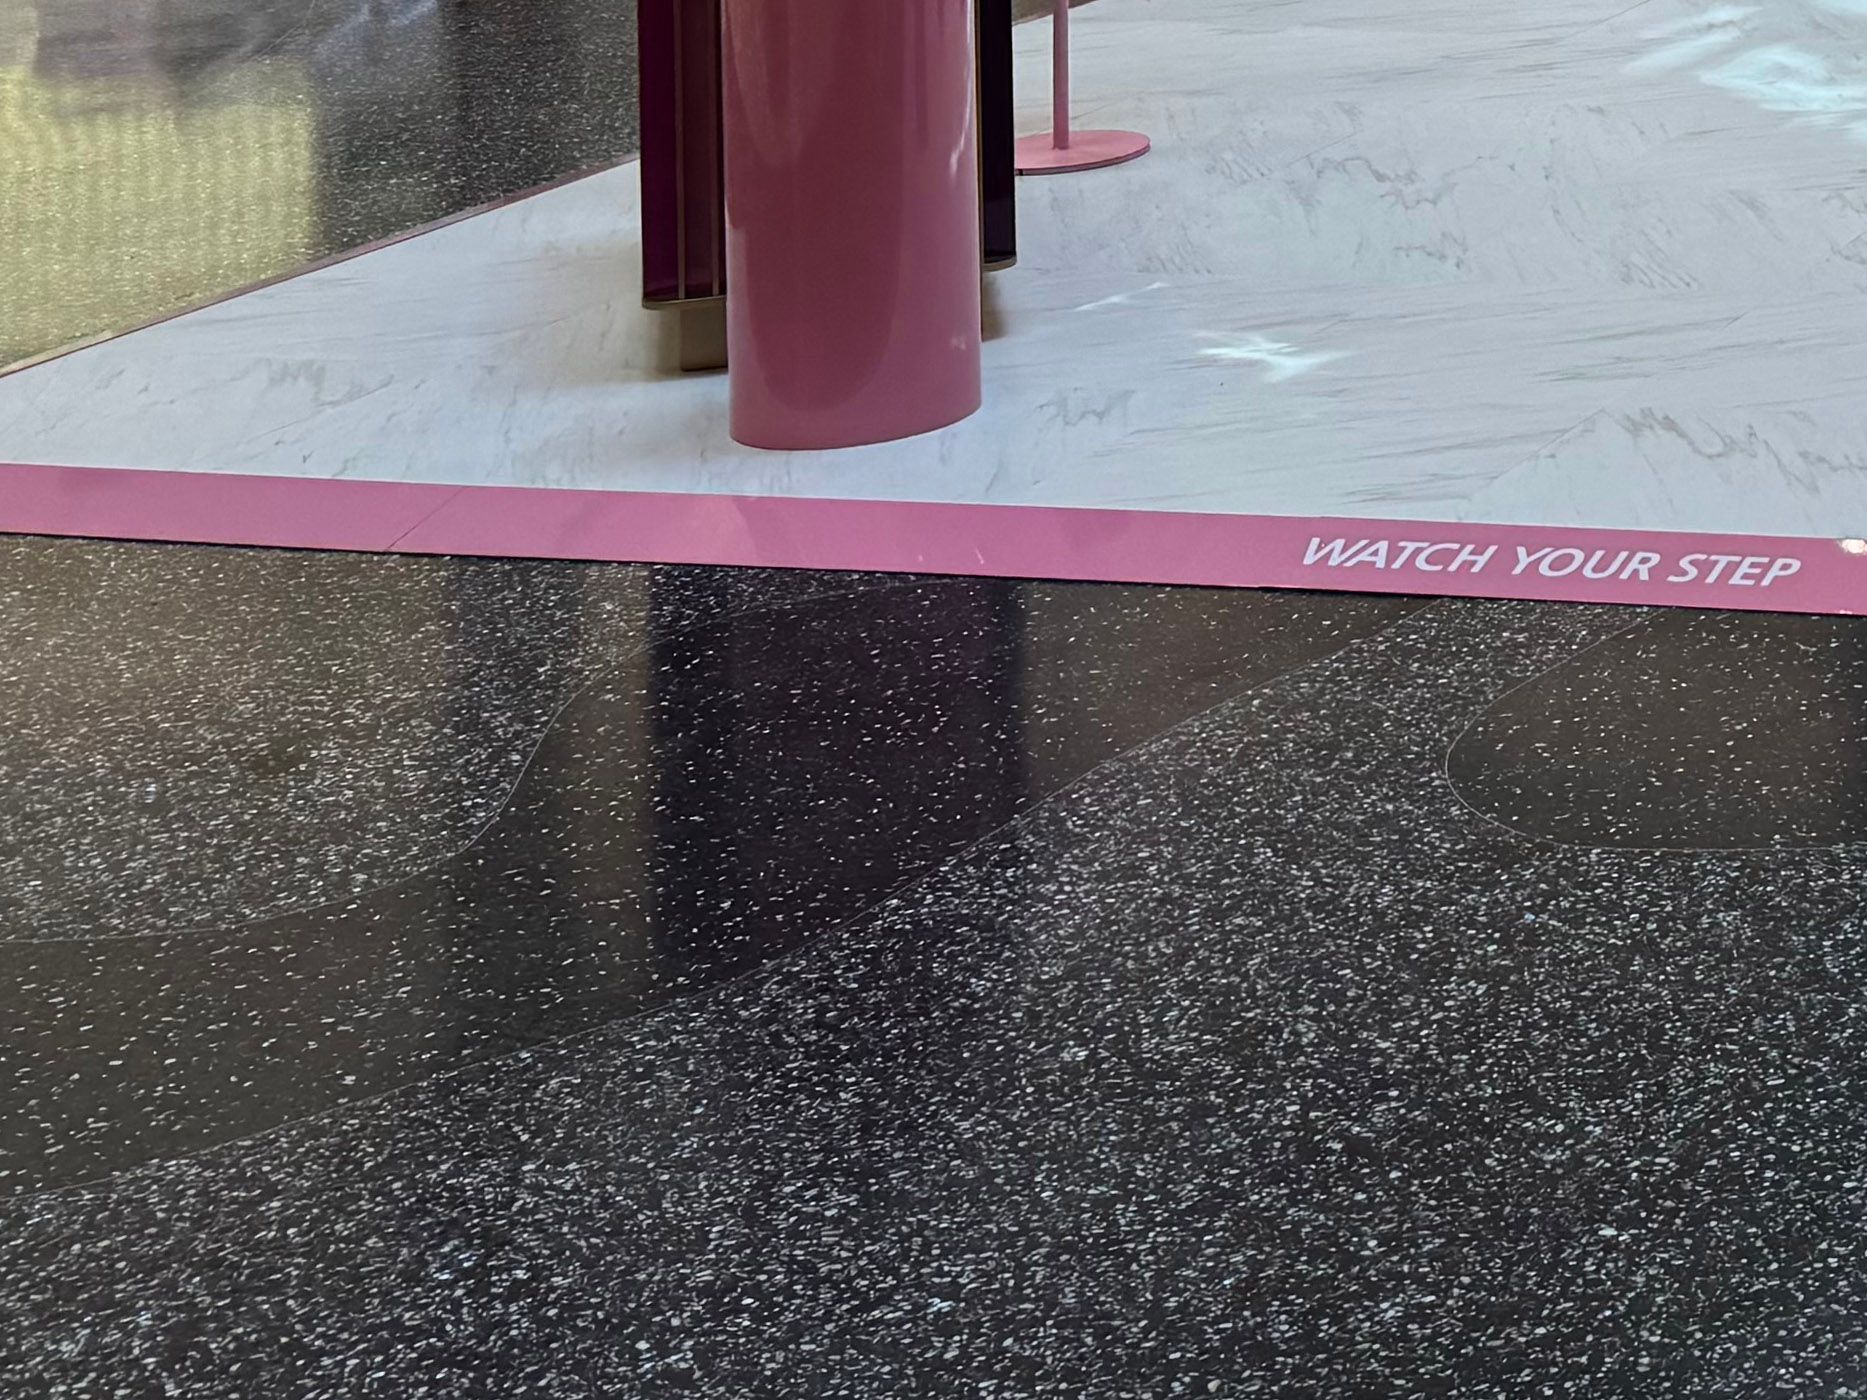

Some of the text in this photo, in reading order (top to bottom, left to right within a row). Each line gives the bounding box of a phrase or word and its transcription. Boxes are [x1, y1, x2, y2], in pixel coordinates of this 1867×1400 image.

[1302, 537, 1802, 588] WATCH YOUR STEP
